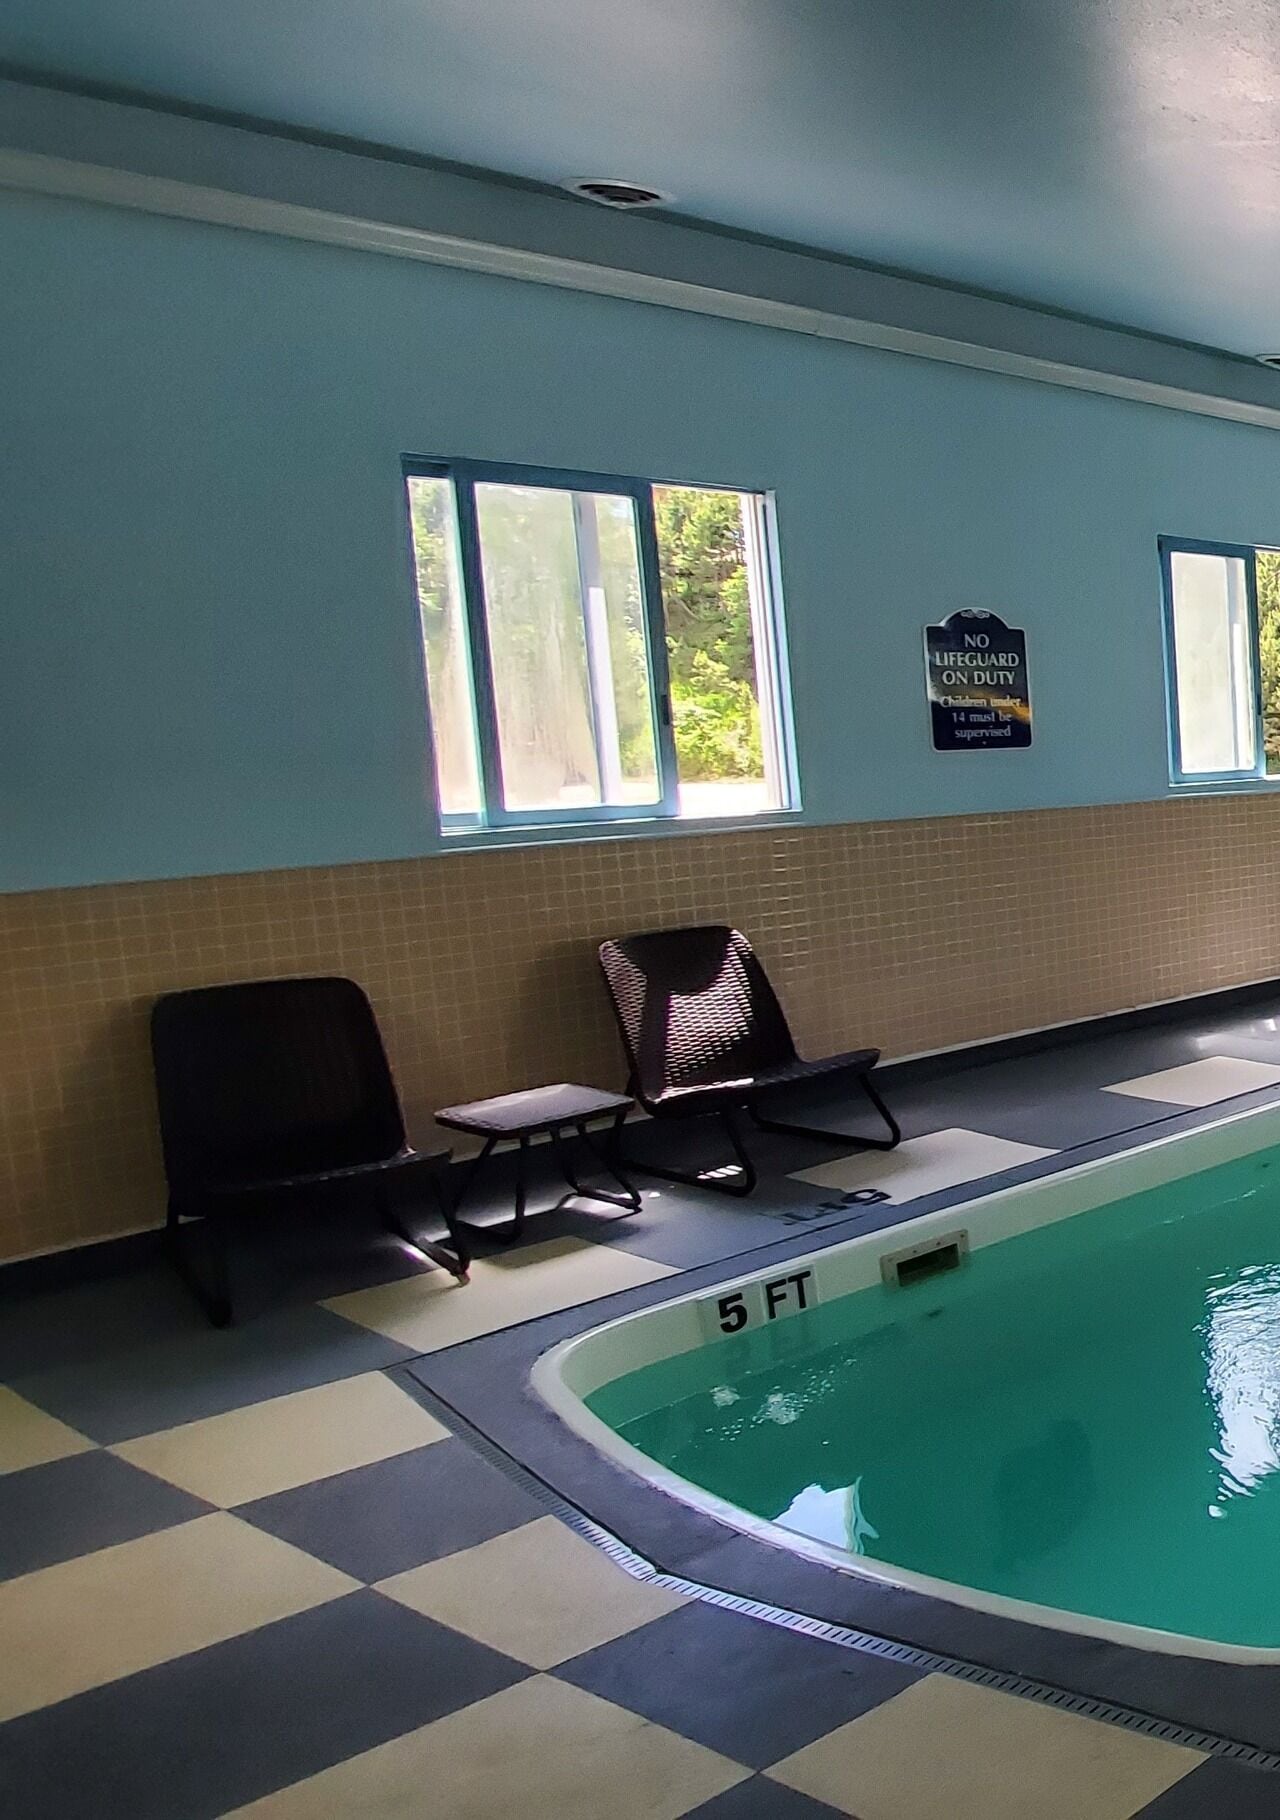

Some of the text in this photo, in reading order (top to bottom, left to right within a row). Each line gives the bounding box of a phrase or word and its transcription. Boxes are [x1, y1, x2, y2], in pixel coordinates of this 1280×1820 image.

[964, 633, 990, 648] NO
[935, 651, 1020, 667] LIFEGUARD
[942, 671, 1016, 685] ON DUTY
[940, 695, 1021, 708] Children under
[951, 711, 1012, 723] 14 must be
[954, 725, 1012, 741] supervised
[718, 1270, 811, 1333] 5 FT
